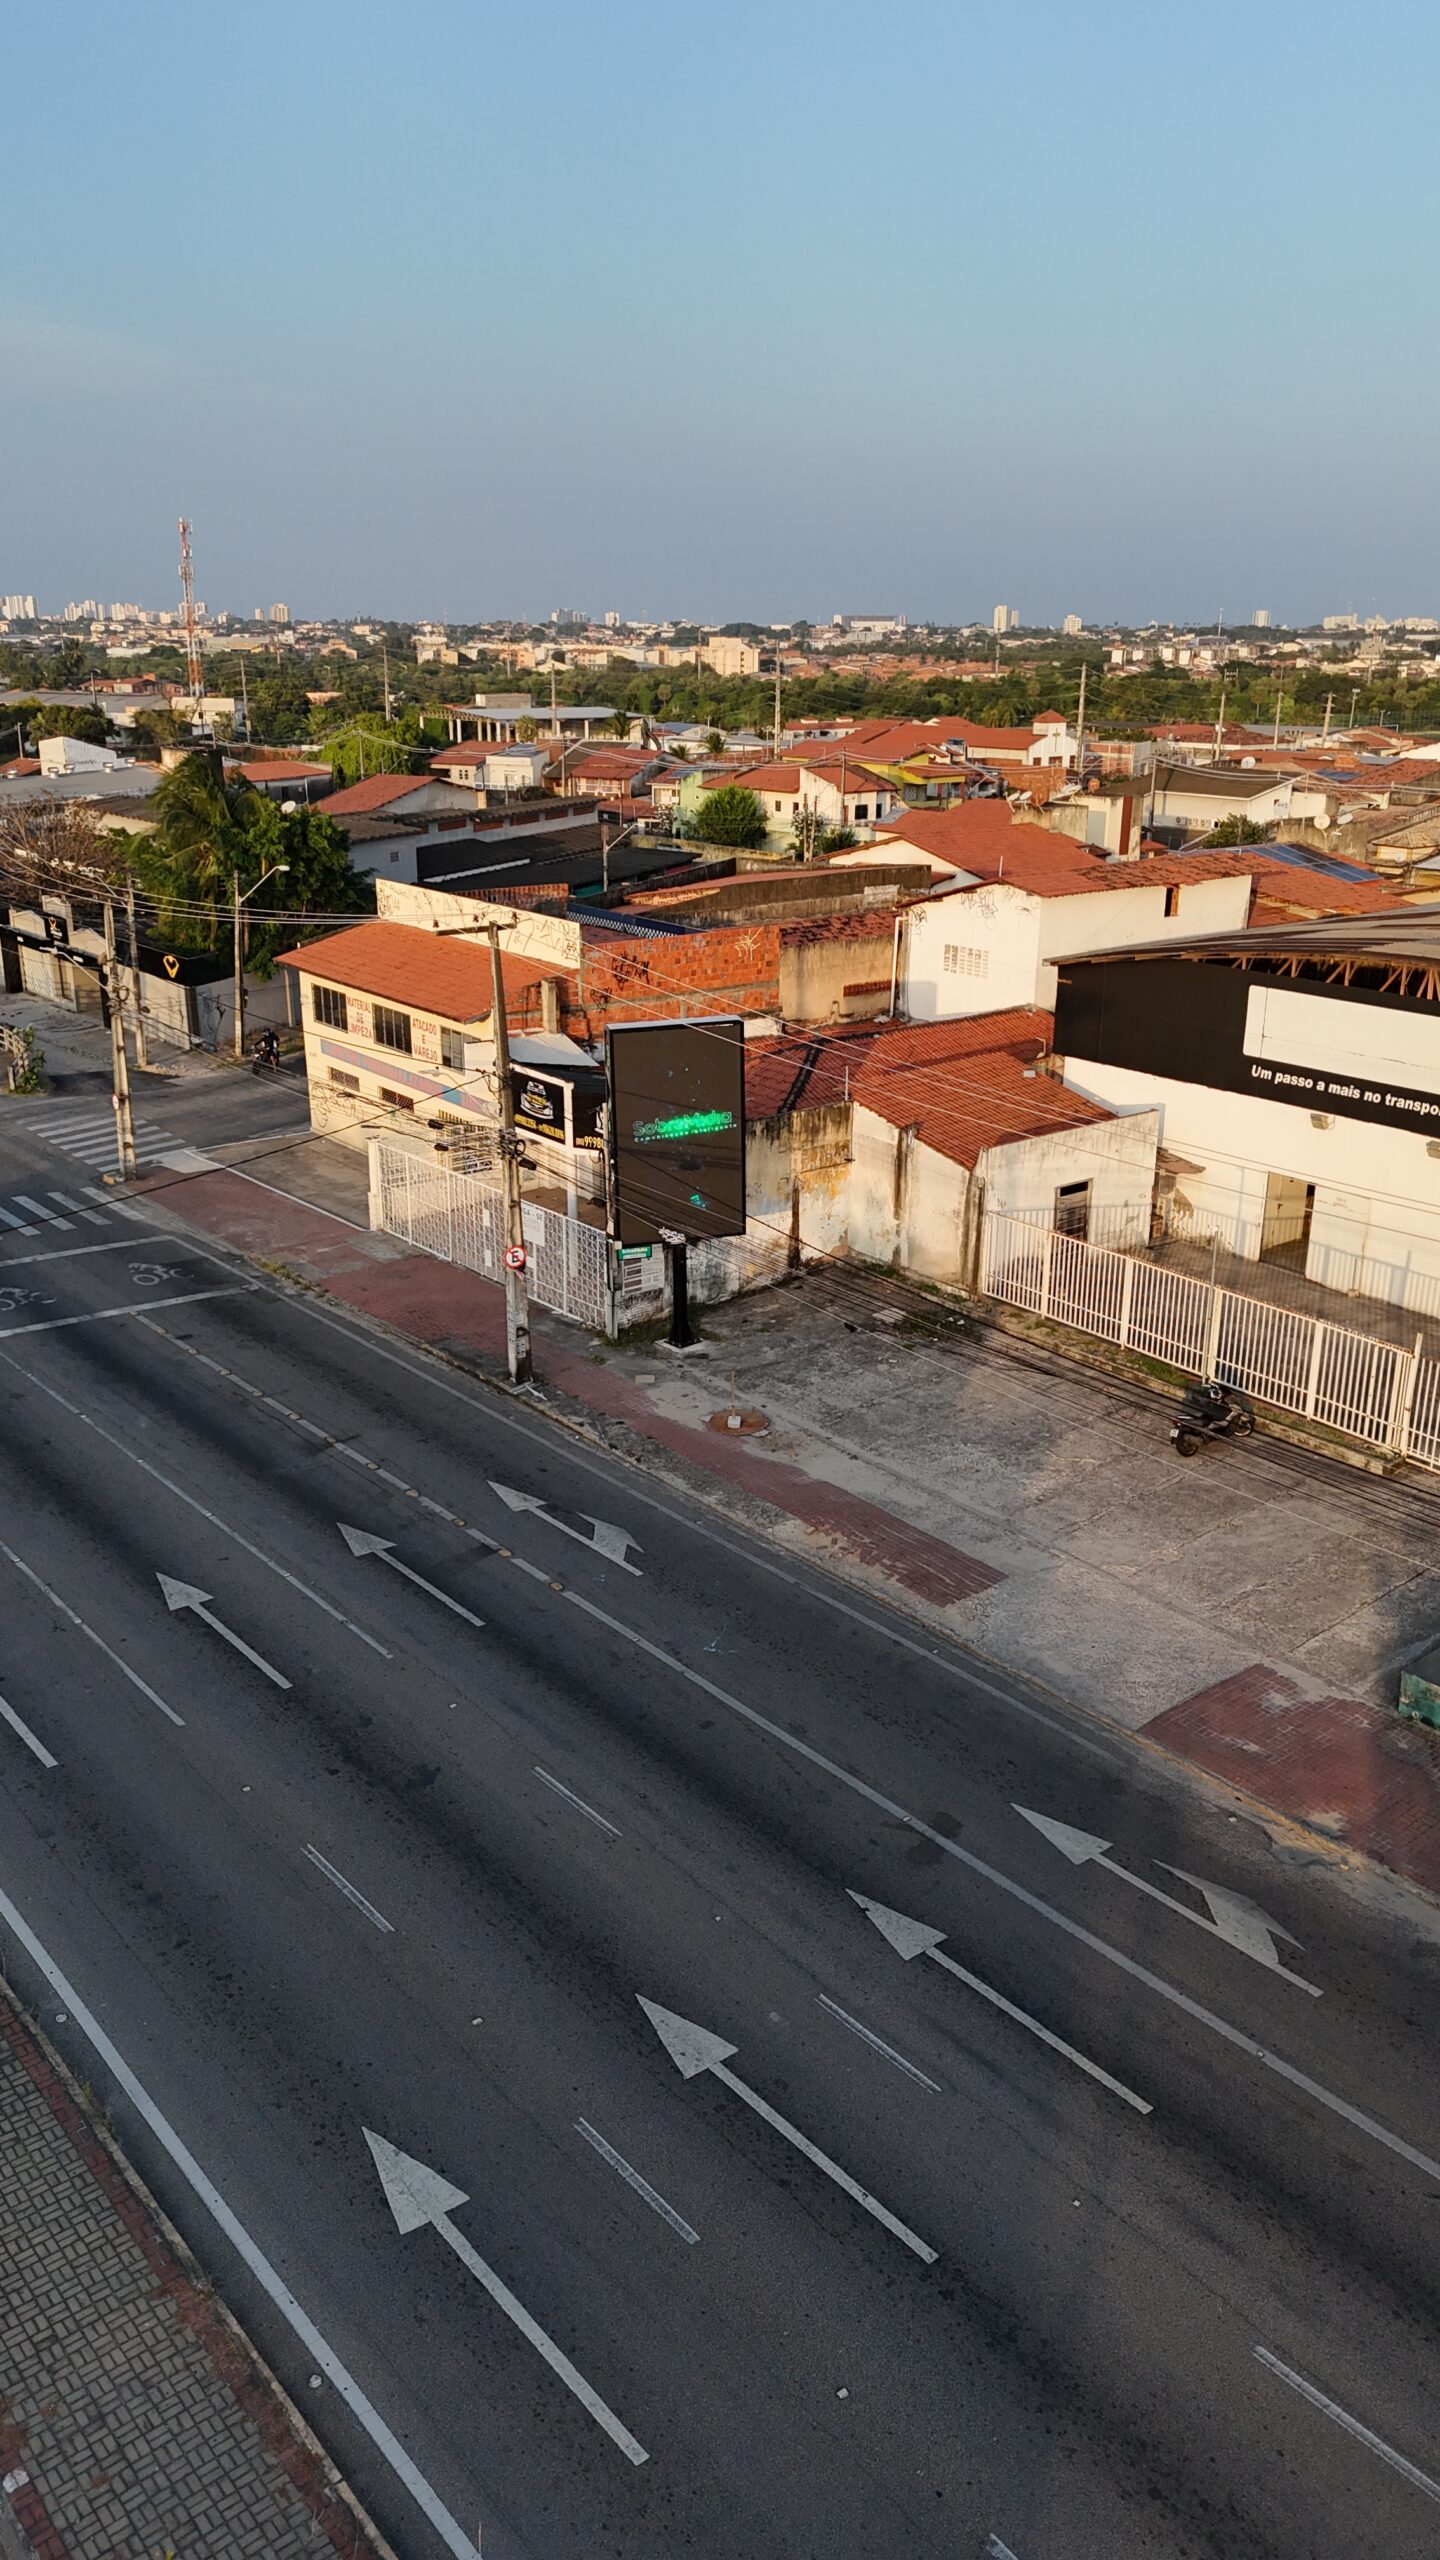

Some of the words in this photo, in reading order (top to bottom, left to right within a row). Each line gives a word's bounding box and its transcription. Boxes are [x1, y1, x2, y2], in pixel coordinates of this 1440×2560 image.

[346, 995, 371, 1013] MATERIAL
[356, 1011, 364, 1024] DE
[349, 1022, 373, 1039] LIMPEZA
[412, 1018, 437, 1036] ATACADO
[421, 1034, 426, 1044] E
[413, 1043, 438, 1062] VAREJO
[1251, 1064, 1272, 1080] Um
[1274, 1071, 1314, 1089] passo
[1316, 1080, 1326, 1091] a
[1327, 1083, 1361, 1099] mais
[1363, 1091, 1381, 1103] no
[1385, 1092, 1440, 1116] transpo
